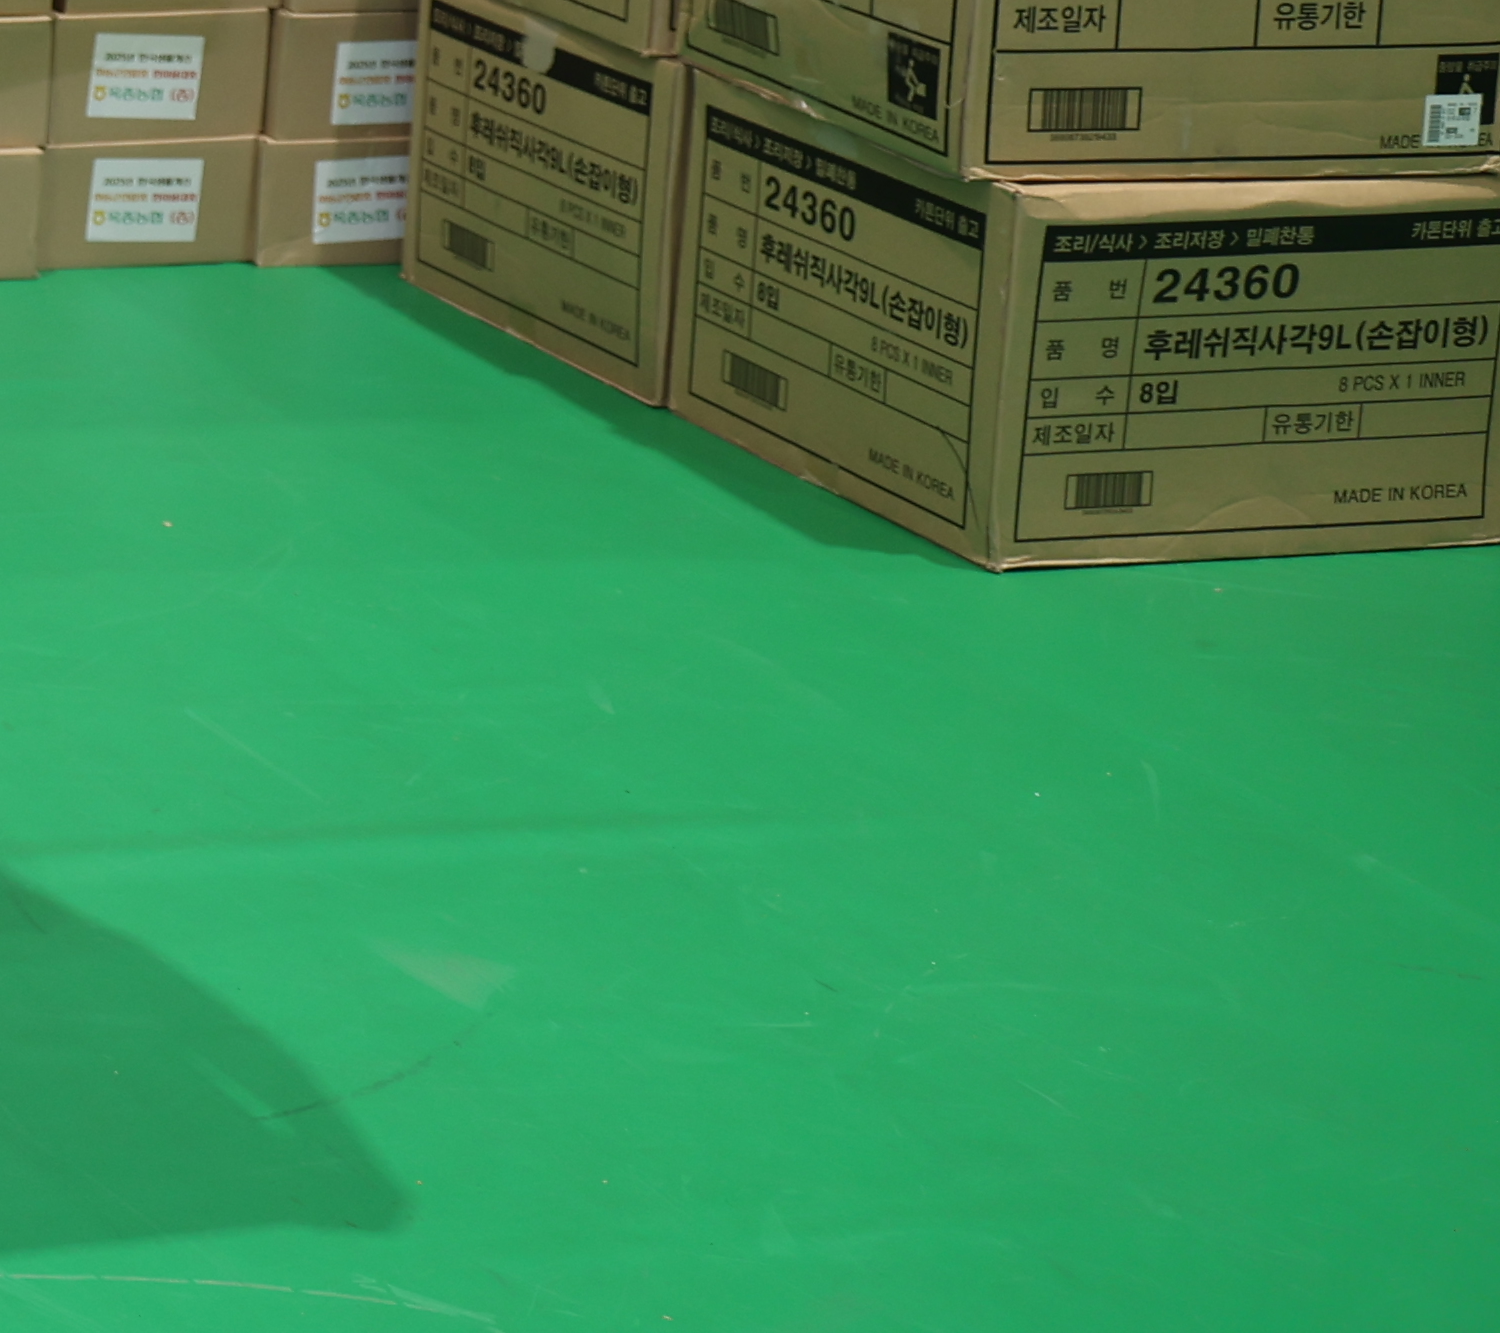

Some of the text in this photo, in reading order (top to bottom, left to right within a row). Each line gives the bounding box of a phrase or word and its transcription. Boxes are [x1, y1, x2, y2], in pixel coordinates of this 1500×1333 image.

[1013, 1, 1367, 33] 제조일자 유통기한
[473, 58, 547, 116] 24360
[1379, 134, 1420, 150] MADE
[764, 175, 857, 242] 24360
[1053, 232, 1134, 253] 조리/식사
[1154, 230, 1227, 251] 조리저장
[1411, 220, 1473, 241] 카톤단위
[1052, 262, 1301, 305] 품 번 24360
[1045, 314, 1489, 363] 품 명 후레쉬직사각9L(손잡이형)
[1040, 388, 1059, 409] 입
[1095, 385, 1115, 406] 수
[1138, 379, 1179, 406] 8입
[1338, 376, 1348, 393] 8
[1352, 375, 1386, 392] PCS
[1388, 374, 1401, 390] X
[1419, 371, 1466, 389] INNER
[1032, 410, 1354, 445] 제조일자 유통기한
[916, 465, 955, 502] KOREA
[1333, 483, 1468, 505] MADE IN KOREA
